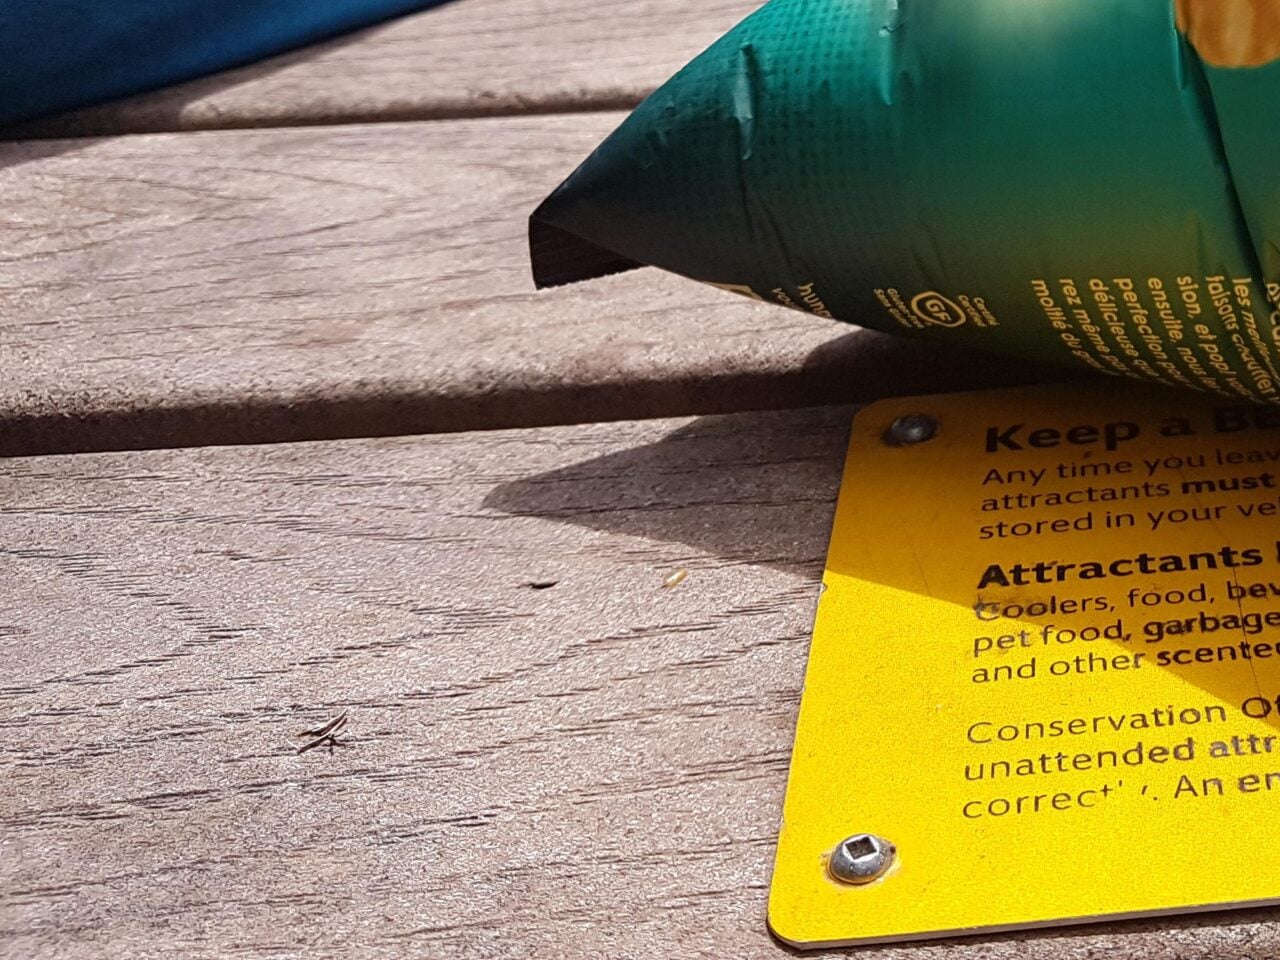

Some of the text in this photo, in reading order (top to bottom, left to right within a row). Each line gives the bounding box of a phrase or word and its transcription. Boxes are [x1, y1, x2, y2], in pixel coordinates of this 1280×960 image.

[925, 299, 953, 321] GF
[1177, 275, 1201, 319] sion,
[1194, 324, 1217, 340] et
[1232, 277, 1253, 308] les
[1031, 278, 1073, 330] moitié
[1061, 332, 1083, 349] du
[1059, 278, 1082, 306] rez
[1072, 309, 1111, 354] même
[1088, 279, 1140, 358] délicieuse
[1112, 278, 1168, 360] perfection
[1147, 277, 1184, 343] ensuite,
[1177, 346, 1208, 376] nous
[985, 419, 1141, 452] Keep
[1160, 416, 1197, 437] a
[982, 467, 1046, 487] Any
[1056, 458, 1133, 479] time
[1144, 455, 1205, 476] you
[981, 482, 1171, 513] attractants
[1181, 471, 1277, 495] must
[979, 511, 1093, 540] stored
[1105, 510, 1135, 528] in
[1147, 504, 1227, 531] your
[976, 545, 1264, 589] Attractants
[974, 592, 1115, 621] Coolers,
[1127, 583, 1216, 609] food,
[973, 630, 1031, 658] pet
[1042, 619, 1132, 646] food,
[971, 657, 1037, 684] and
[1049, 651, 1146, 677] other
[966, 704, 1227, 745] Conservation
[964, 736, 1195, 781] unattended
[1174, 774, 1224, 799] An
